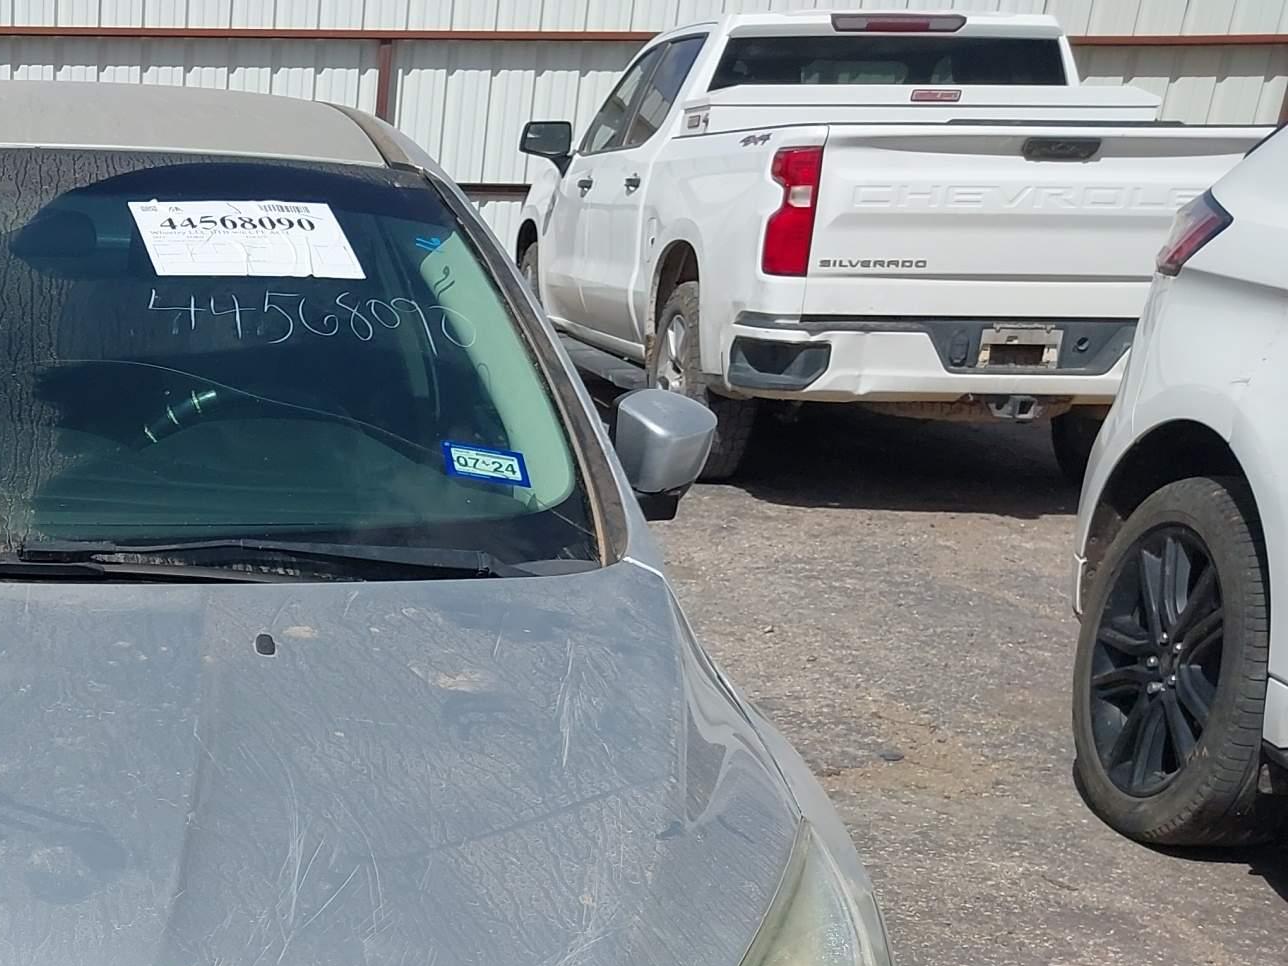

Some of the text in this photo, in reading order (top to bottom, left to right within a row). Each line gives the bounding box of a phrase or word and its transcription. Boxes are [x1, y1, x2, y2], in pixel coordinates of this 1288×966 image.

[160, 214, 316, 232] 44568090
[819, 259, 927, 269] SILVERADO
[148, 289, 477, 357] 44568090
